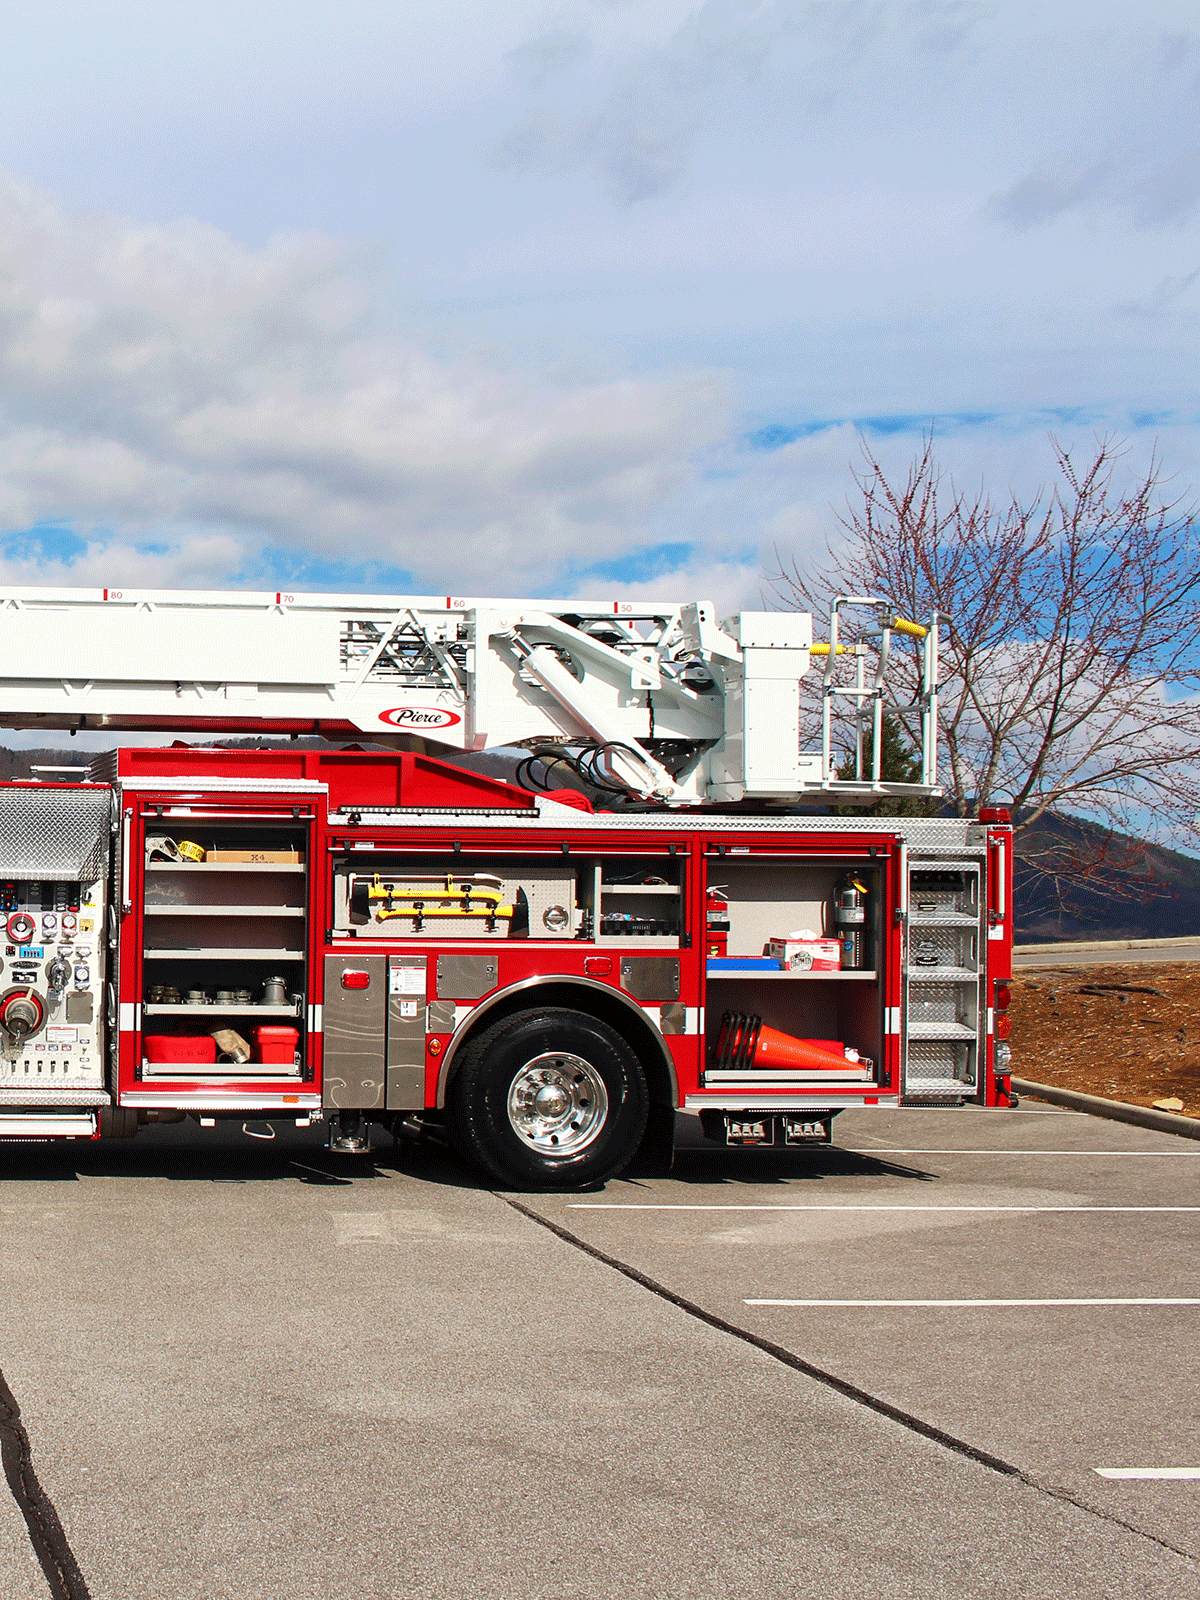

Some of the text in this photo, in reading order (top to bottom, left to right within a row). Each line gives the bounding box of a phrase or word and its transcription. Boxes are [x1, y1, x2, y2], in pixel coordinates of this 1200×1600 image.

[283, 595, 295, 603] 70
[453, 600, 466, 608] 60
[620, 604, 633, 613] 50
[396, 709, 443, 724] Pierce
